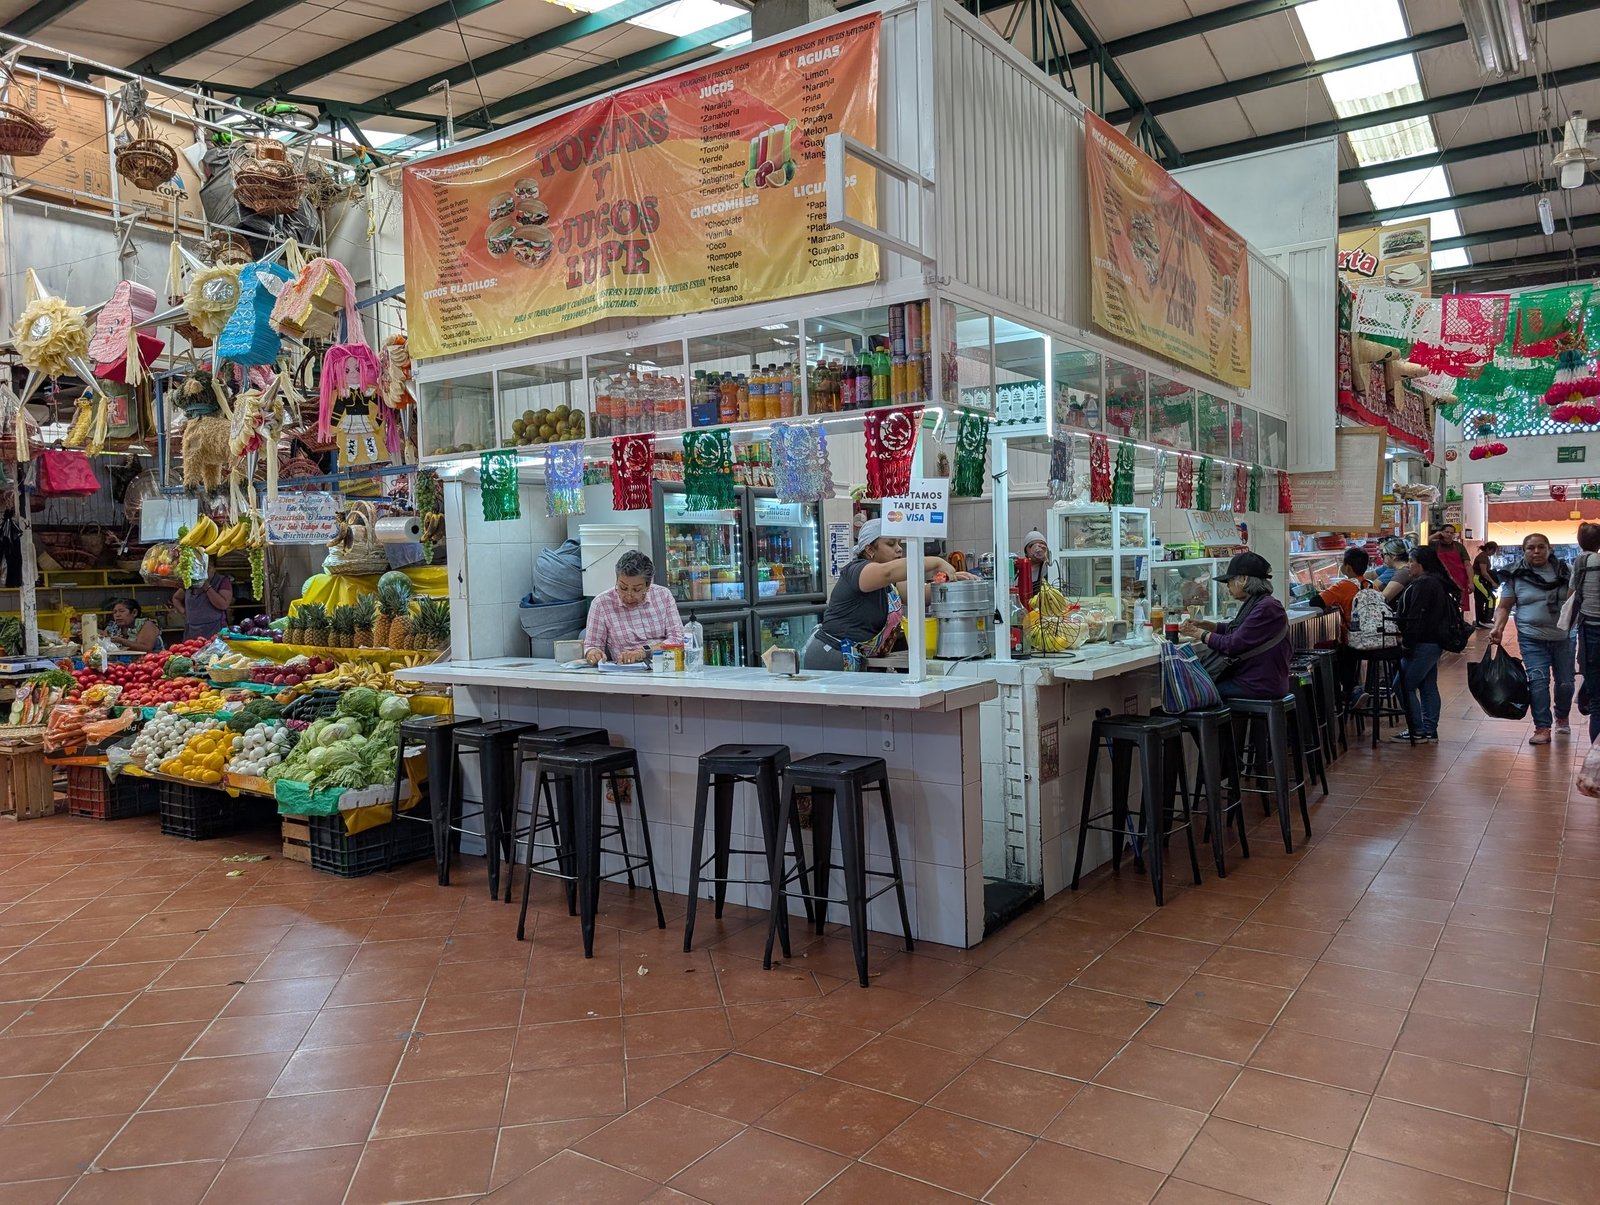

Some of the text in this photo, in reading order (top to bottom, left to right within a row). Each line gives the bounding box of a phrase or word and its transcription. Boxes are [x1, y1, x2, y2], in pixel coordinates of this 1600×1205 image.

[797, 44, 842, 68] AGUAS
[804, 68, 829, 81] Limon
[699, 80, 735, 99] JUGOS
[804, 76, 835, 93] Naranja
[704, 100, 732, 112] Naranja
[804, 103, 826, 115] Fresa
[703, 107, 740, 122] Zanahoria
[803, 112, 833, 126] Papaya
[703, 120, 731, 133] Betabel
[803, 125, 828, 137] Melon
[536, 105, 670, 177] TORTAS
[703, 129, 741, 143] Mandarina
[703, 144, 729, 156] Toronja
[802, 139, 826, 150] Guay
[702, 155, 723, 164] Verde
[803, 152, 826, 162] Mang
[701, 160, 746, 175] Combinados
[701, 174, 736, 187] Antigripal
[793, 174, 858, 198] LICUS
[702, 183, 740, 198] Energetico
[810, 200, 827, 210] Pap
[708, 216, 742, 230] Chocolate
[810, 212, 828, 221] Fres
[558, 196, 660, 254] JUGOS
[810, 222, 837, 233] Plata
[708, 229, 733, 240] Vainilla
[811, 231, 845, 244] Manzana
[708, 242, 727, 251] Coco
[811, 243, 845, 256] Guayaba
[709, 250, 742, 262] Rompope
[812, 252, 859, 267] Combinados
[566, 239, 651, 290] LUPE
[710, 261, 739, 273] Nescafe
[1338, 249, 1379, 277] rta
[711, 274, 731, 283] Fresa
[423, 278, 498, 301] OTROS PLATILLOS:
[712, 284, 738, 294] Platano
[713, 294, 743, 305] Guayaba
[442, 312, 473, 323] Sandwiches
[721, 431, 730, 474] MEXICO
[893, 502, 938, 511] TARJETAS
[906, 513, 925, 522] VISA
[283, 531, 329, 540] Bienvenidos
[1216, 527, 1236, 540] DOG
